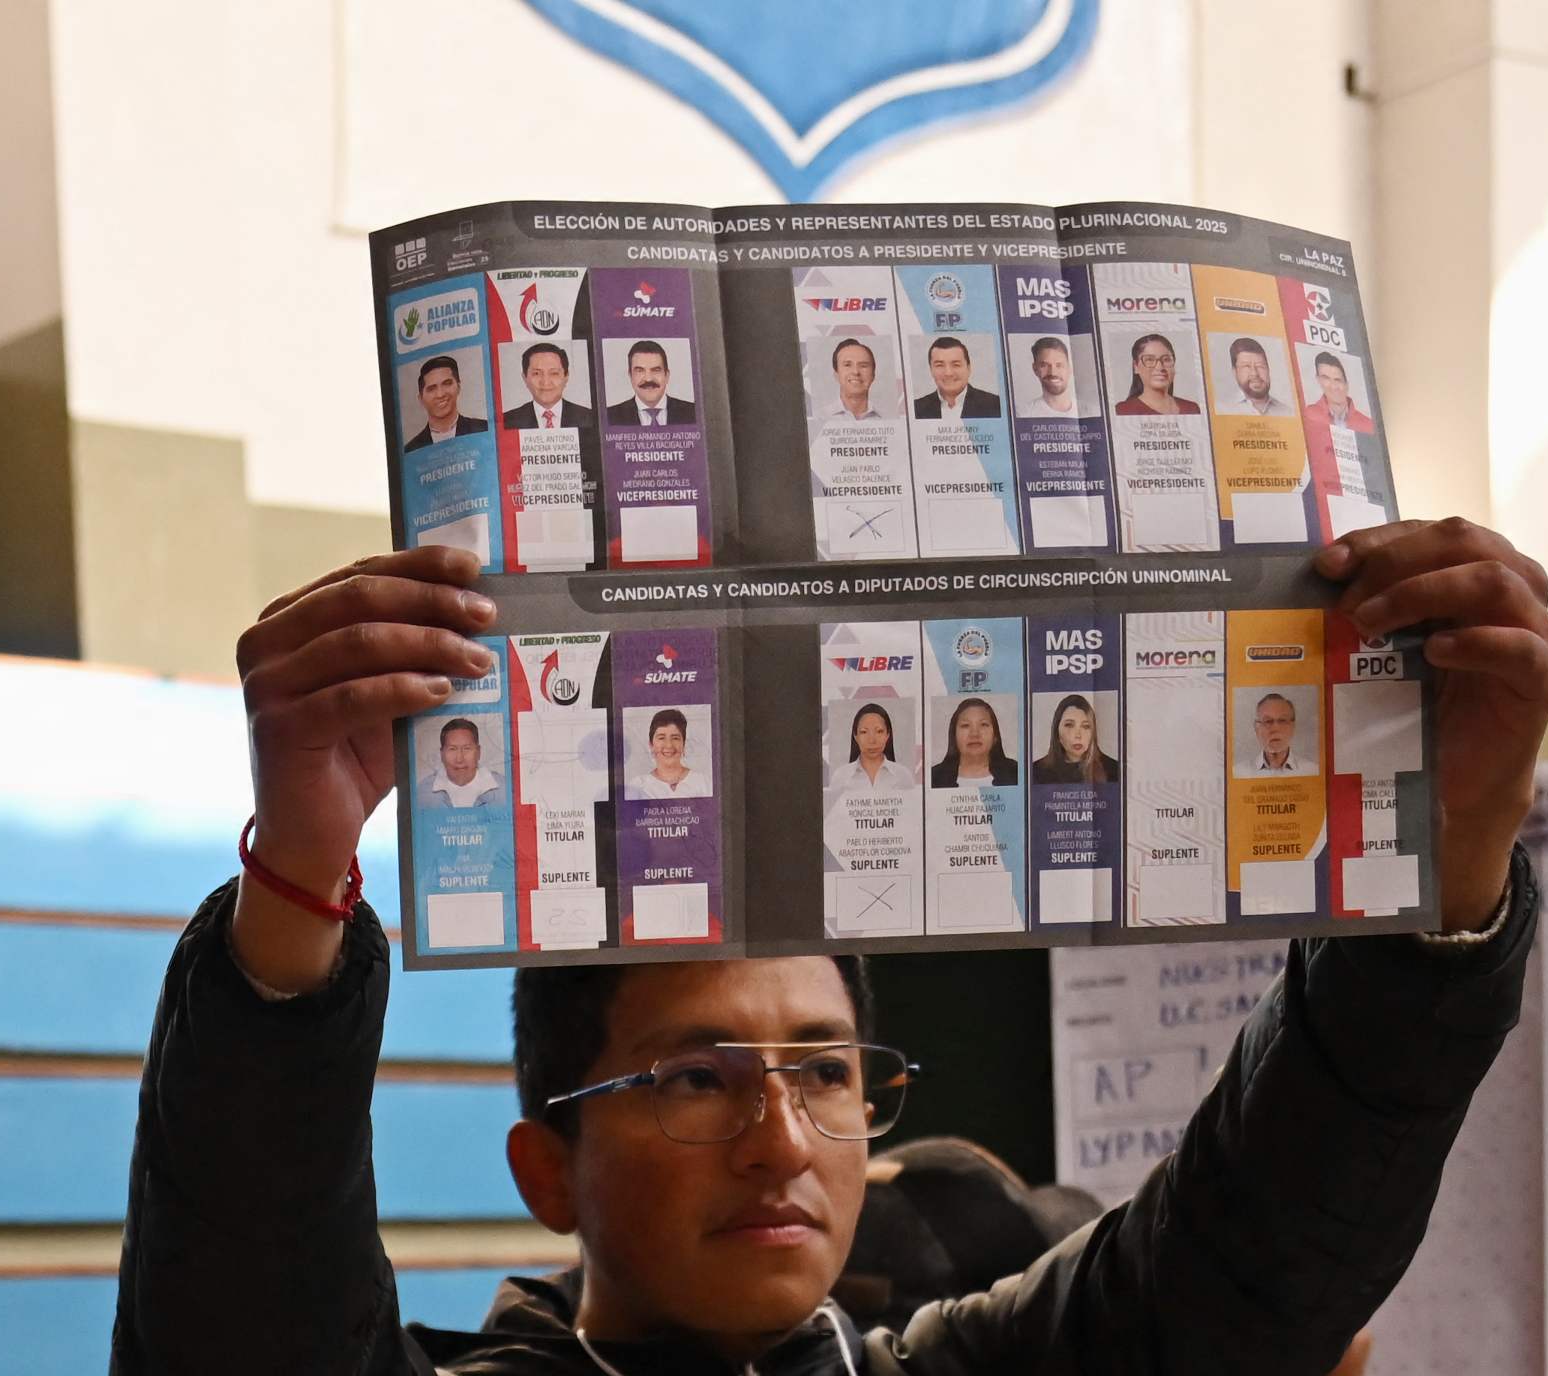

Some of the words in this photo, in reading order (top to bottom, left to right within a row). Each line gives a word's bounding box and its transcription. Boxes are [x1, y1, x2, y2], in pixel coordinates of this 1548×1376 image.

[533, 212, 620, 230] ELECCIÓN
[624, 214, 650, 230] DE
[652, 214, 772, 234] AUTORIDADES
[775, 217, 787, 232] Y
[790, 214, 947, 232] REPRESENTANTES
[952, 214, 987, 230] DEL
[991, 213, 1055, 231] ESTADO
[1058, 214, 1192, 232] PLURINACIONAL
[1195, 217, 1228, 234] 2025
[626, 246, 729, 264] CANDIDATAS
[733, 247, 745, 262] Y
[748, 245, 855, 261] CANDIDATOS
[858, 245, 870, 258] A
[873, 244, 974, 260] PRESIDENTE
[978, 245, 989, 258] Y
[993, 242, 1127, 260] VICEPRESIDENTE
[1303, 247, 1319, 262] LA
[1322, 250, 1346, 268] PAZ
[396, 253, 428, 272] OEP
[497, 270, 533, 281] LIBERTAD
[539, 269, 580, 279] PROGRESO
[1015, 277, 1072, 300] MAS
[427, 298, 476, 322] ALIANZA
[622, 301, 675, 318] SÚMATE
[1017, 300, 1075, 320] IPSP
[427, 313, 477, 335] POPULAR
[933, 312, 962, 329] FP
[1308, 326, 1342, 348] PDC
[605, 431, 635, 442] MANFRED
[636, 431, 670, 441] ARMANDO
[670, 431, 702, 441] ANTONIO
[830, 445, 889, 458] PRESIDENTE
[931, 444, 991, 456] PRESIDENTE
[1033, 442, 1091, 454] PRESIDENTE
[1133, 439, 1192, 452] PRESIDENTE
[1232, 439, 1289, 451] PRESIDENTE
[520, 453, 581, 465] PRESIDENTE
[624, 450, 685, 463] PRESIDENTE
[419, 459, 477, 486] PRESIDENTE
[924, 482, 1005, 495] VICEPRESIDENTE
[1026, 478, 1105, 493] VICEPRESIDENTE
[1127, 477, 1205, 490] VICEPRESIDENTE
[1226, 477, 1303, 488] VICEPRESIDENTE
[616, 489, 699, 503] VICEPRESIDENTE
[822, 484, 903, 498] VICEPRESIDENTE
[511, 491, 596, 506] VICEPRESIDENTE
[413, 497, 490, 529] VICEPRESIDENTE
[601, 582, 708, 603] CANDIDATAS
[711, 582, 724, 600] Y
[727, 579, 835, 598] CANDIDATOS
[838, 578, 851, 595] A
[853, 576, 949, 595] DIPUTADOS
[953, 573, 976, 591] DE
[978, 565, 1129, 590] CIRCUNSCRIPCIÓN
[1131, 567, 1232, 586] UNINOMINAL
[518, 636, 555, 647] LIBERTAD
[560, 635, 602, 645] PROGRESO
[1044, 629, 1104, 651] MAS
[1044, 653, 1104, 676] IPSP
[1355, 656, 1398, 678] PDC
[643, 669, 698, 684] SÚMATE
[960, 670, 988, 690] FP
[1154, 807, 1195, 819] TITULAR
[1256, 803, 1297, 815] TITULAR
[953, 814, 994, 826] TITULAR
[1055, 811, 1094, 823] TITULAR
[855, 818, 895, 831] TITULAR
[544, 830, 585, 842] TITULAR
[647, 826, 689, 839] TITULAR
[441, 834, 483, 847] TITULAR
[1150, 847, 1200, 861] SUPLENTE
[1252, 843, 1302, 856] SUPLENTE
[850, 858, 900, 871] SUPLENTE
[949, 854, 999, 868] SUPLENTE
[1050, 851, 1098, 864] SUPLENTE
[541, 871, 591, 884] SUPLENTE
[644, 866, 694, 880] SUPLENTE
[438, 875, 490, 888] SUPLENTE
[1092, 1061, 1153, 1106] AP
